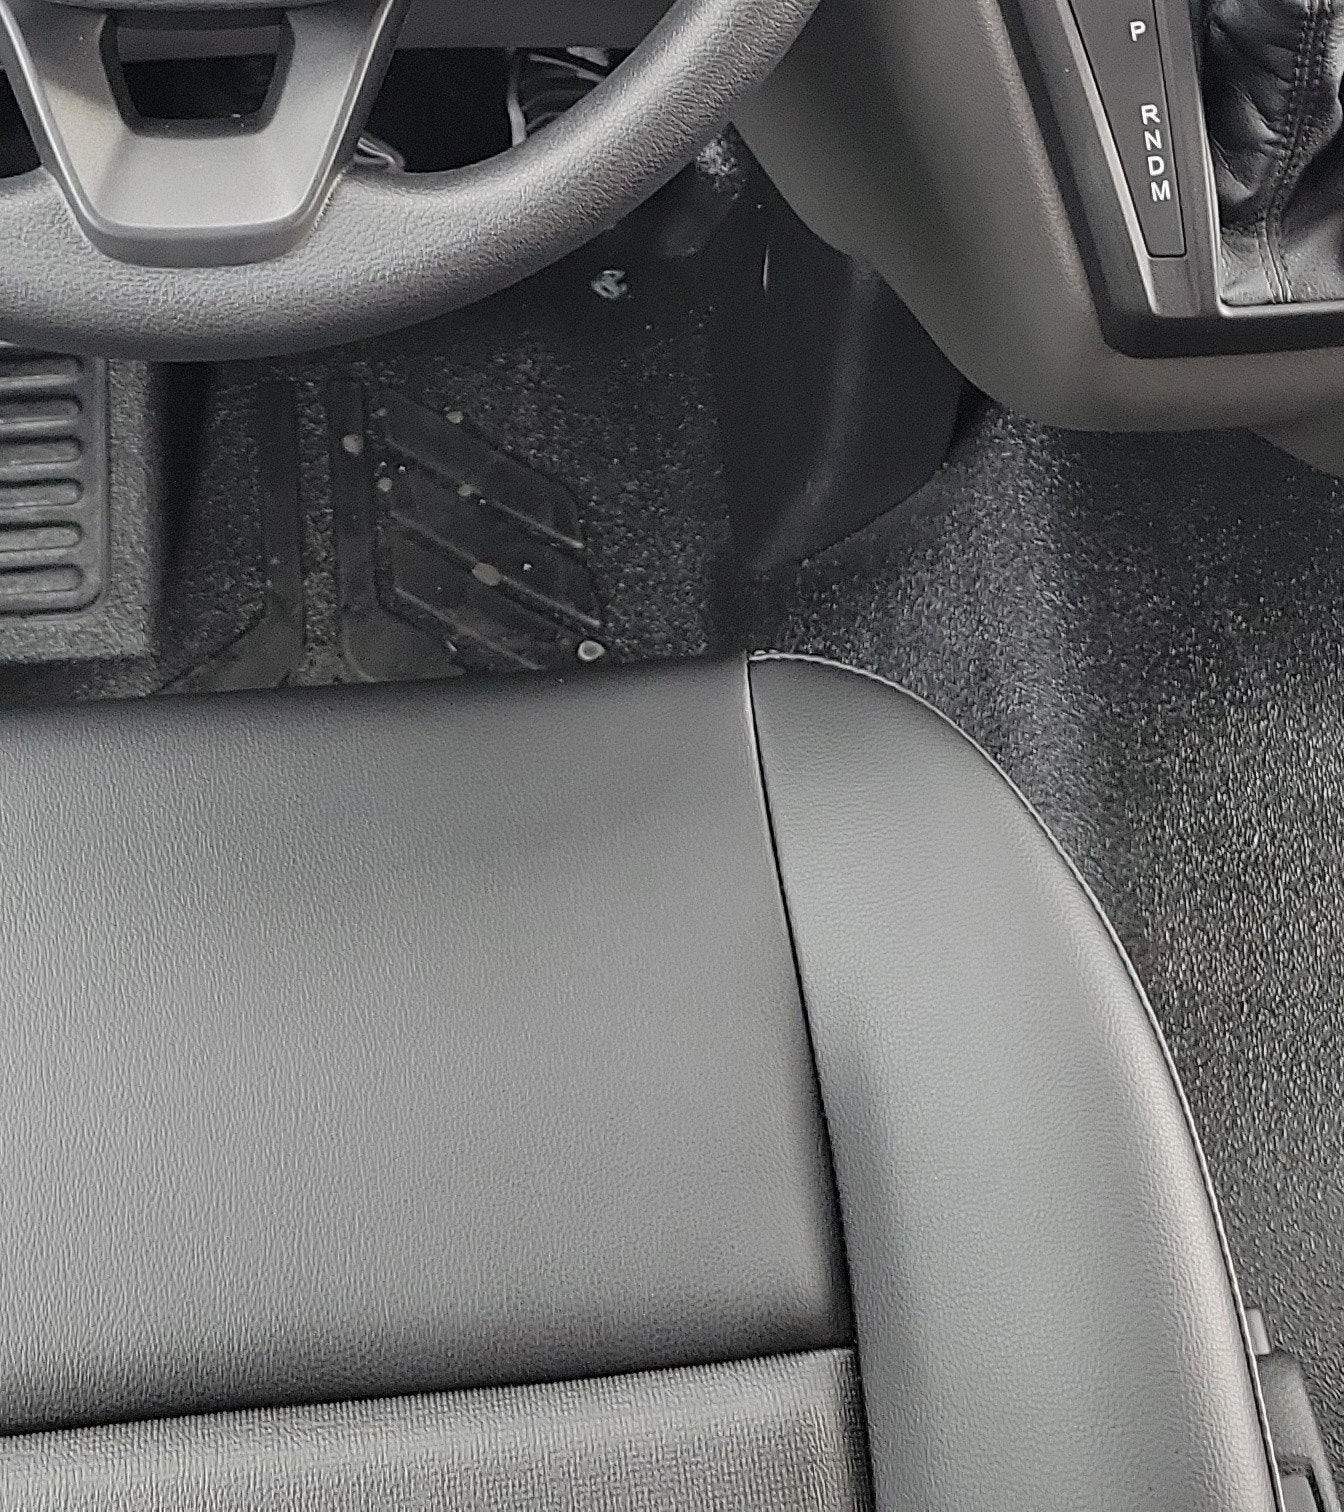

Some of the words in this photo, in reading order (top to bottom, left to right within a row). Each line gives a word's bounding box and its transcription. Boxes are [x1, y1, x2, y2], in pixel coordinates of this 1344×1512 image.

[1129, 20, 1147, 42] P
[1140, 104, 1161, 125] R
[1144, 130, 1162, 152] N
[1146, 155, 1166, 177] D
[1150, 179, 1172, 202] M
